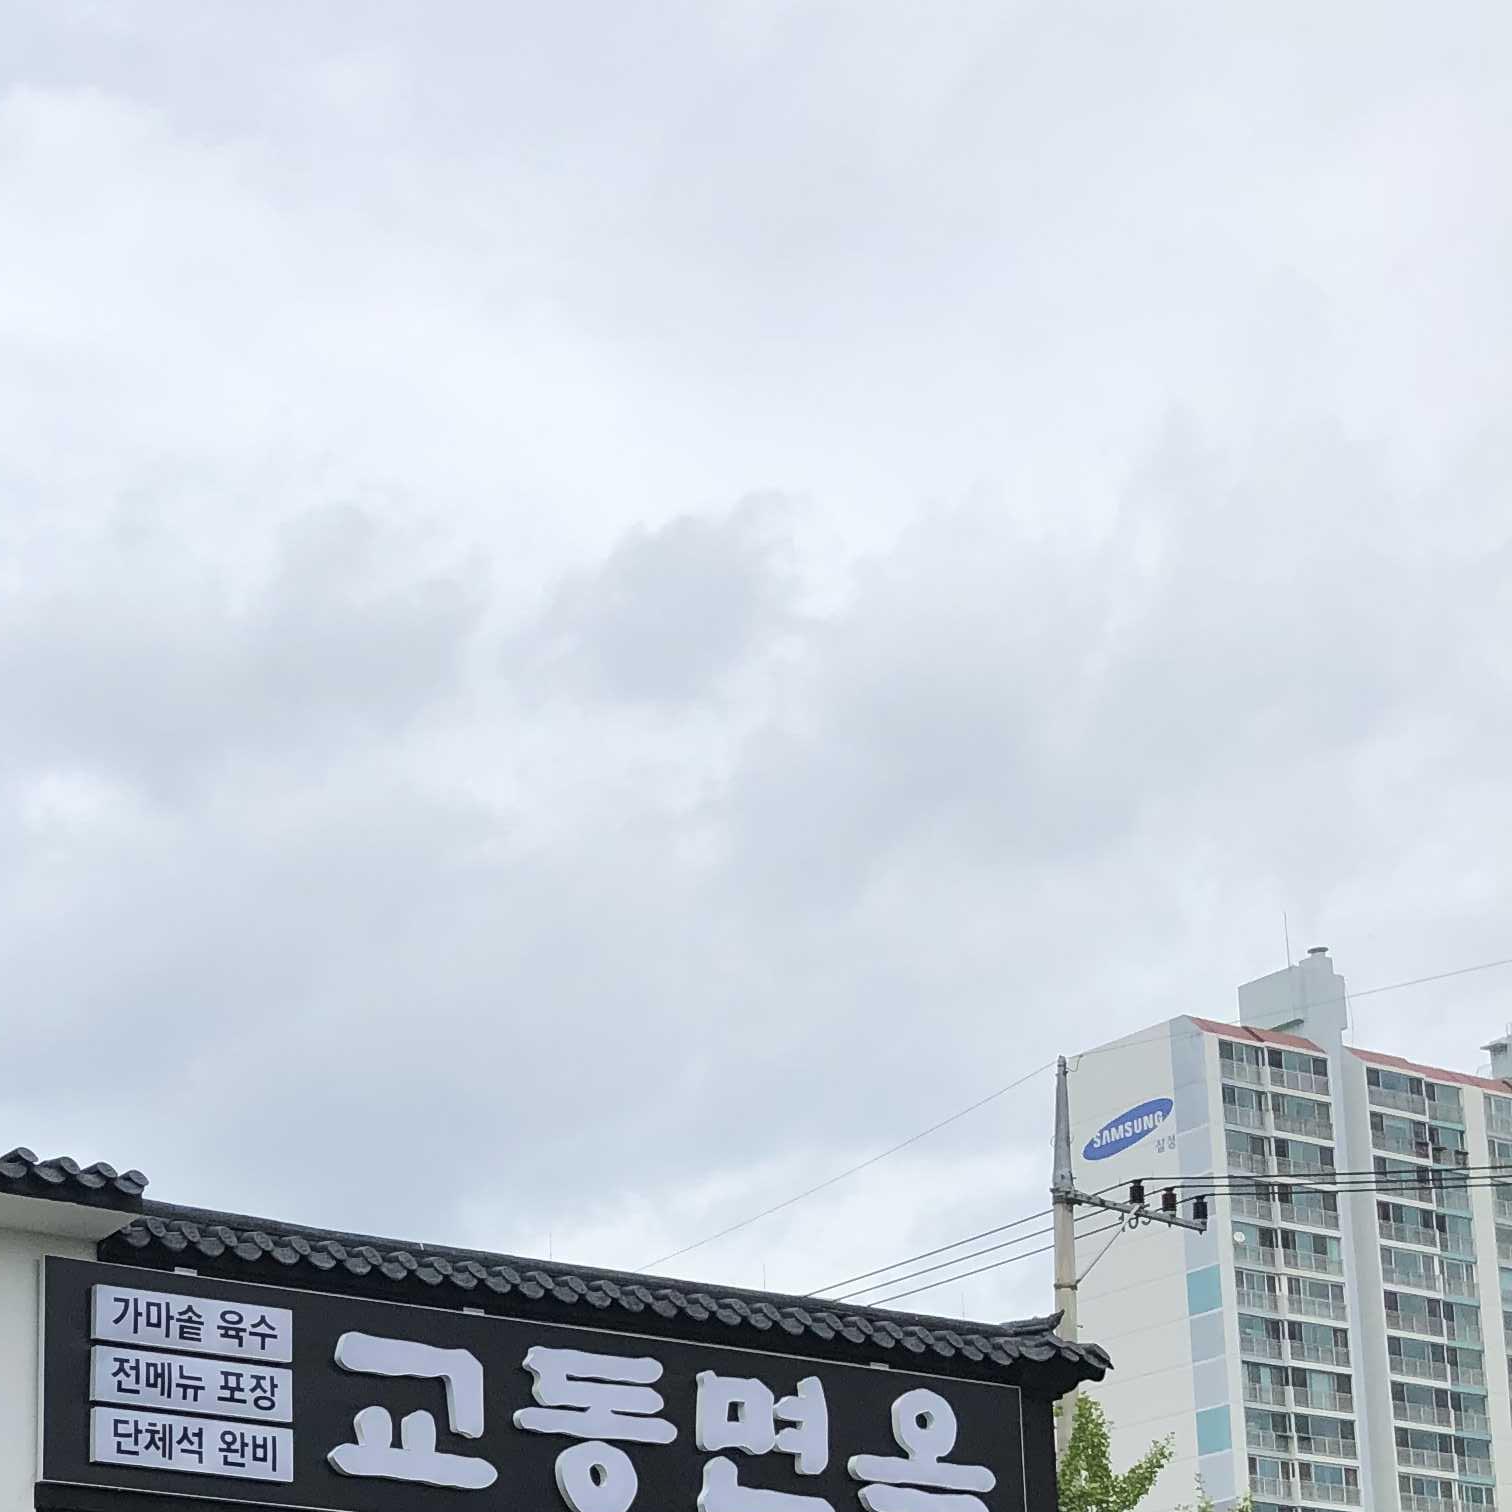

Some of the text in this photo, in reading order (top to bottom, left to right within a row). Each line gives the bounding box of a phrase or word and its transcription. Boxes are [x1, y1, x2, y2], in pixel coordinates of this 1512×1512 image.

[1092, 1110, 1164, 1149] SAMSUNG
[112, 1296, 279, 1351] 가마솥 육수
[111, 1356, 279, 1411] 전메뉴 포장
[112, 1418, 278, 1473] 단체석 완비
